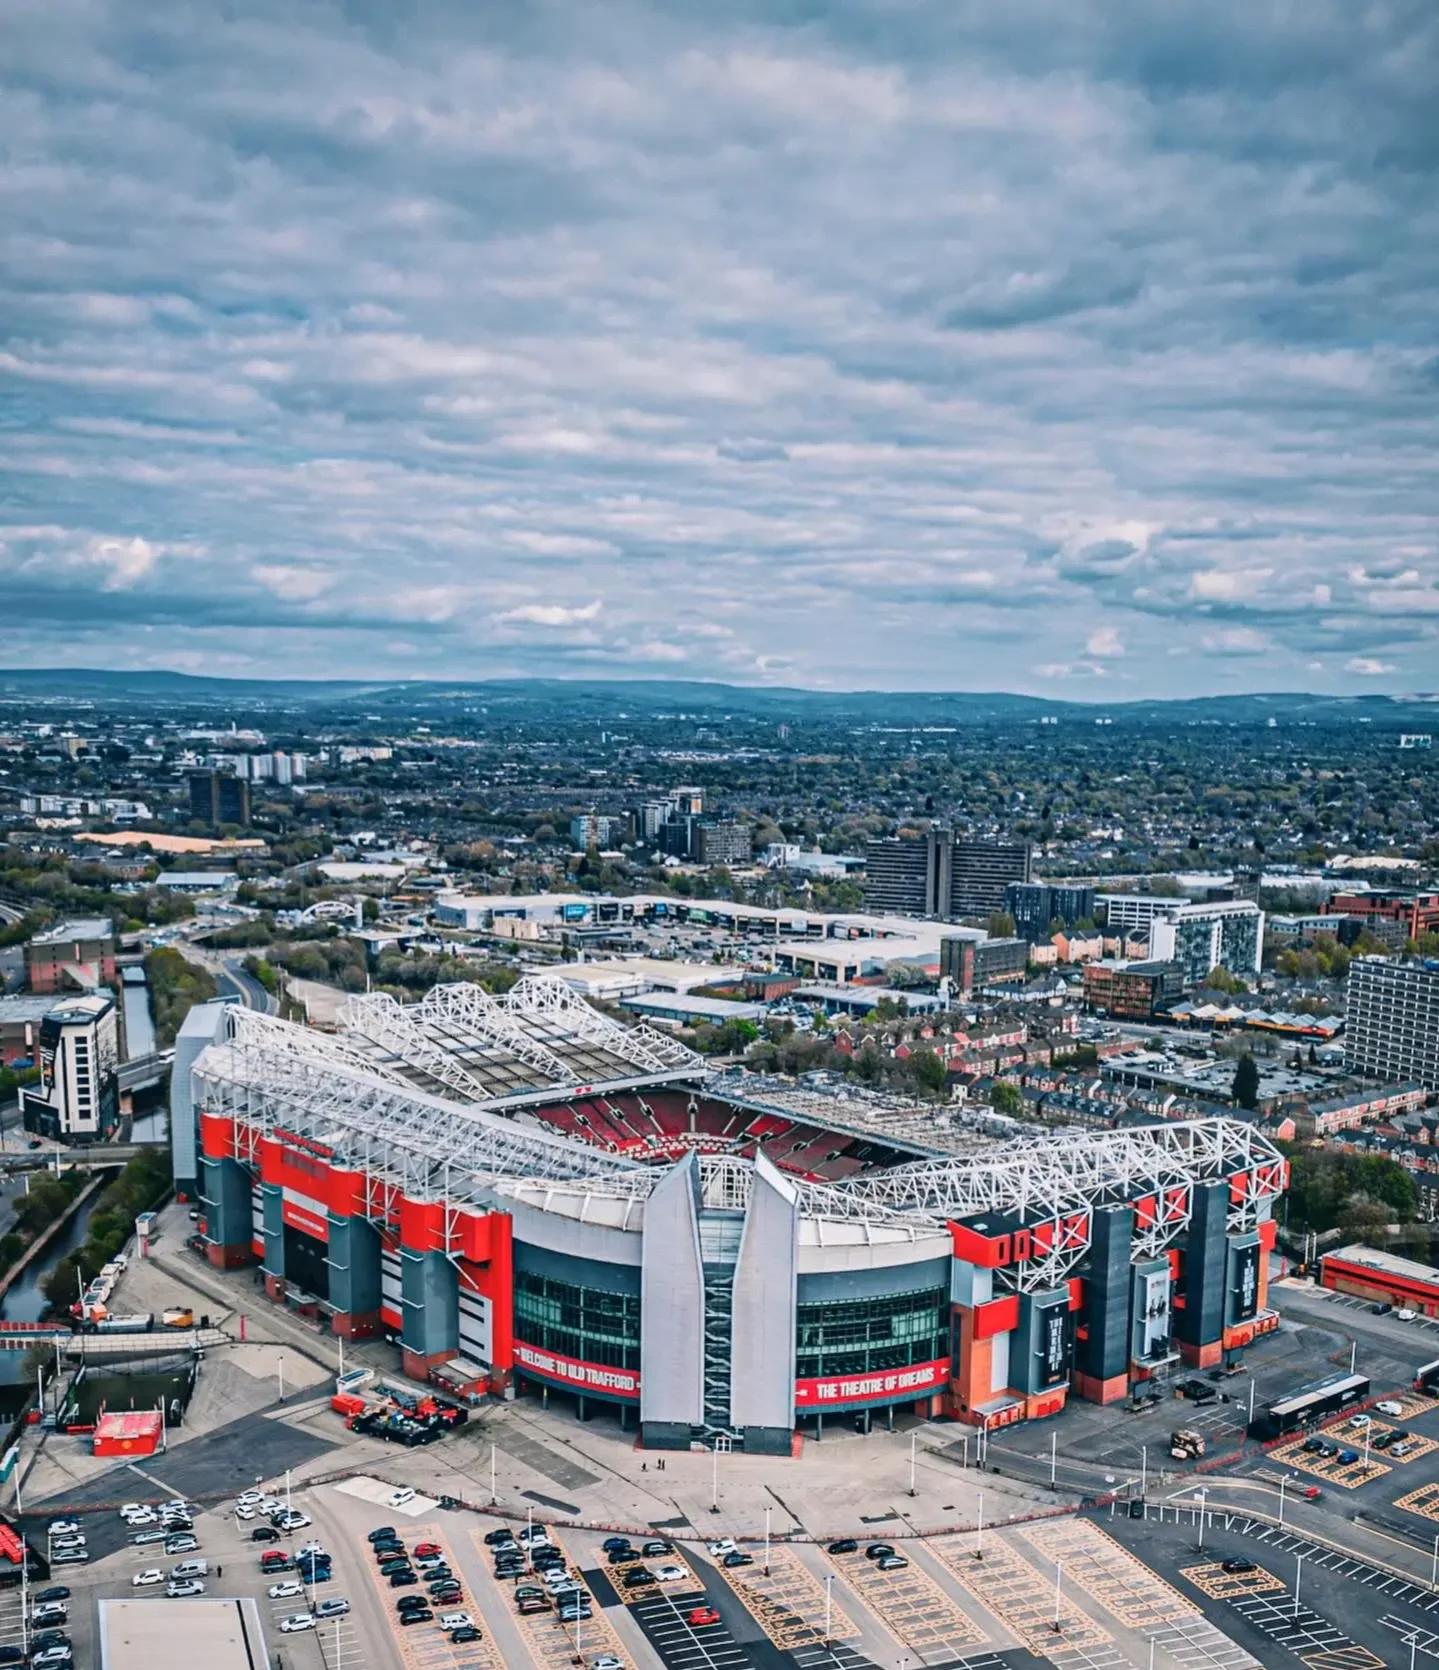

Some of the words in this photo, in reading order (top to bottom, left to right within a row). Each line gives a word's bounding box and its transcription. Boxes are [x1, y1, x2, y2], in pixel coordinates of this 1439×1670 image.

[556, 1360, 567, 1376] TO
[568, 1364, 585, 1381] OLD
[586, 1368, 634, 1391] TRAFFORD
[817, 1383, 838, 1398] THE
[839, 1380, 884, 1397] THEATRE
[884, 1375, 898, 1391] OF
[898, 1367, 935, 1387] DREAMS
